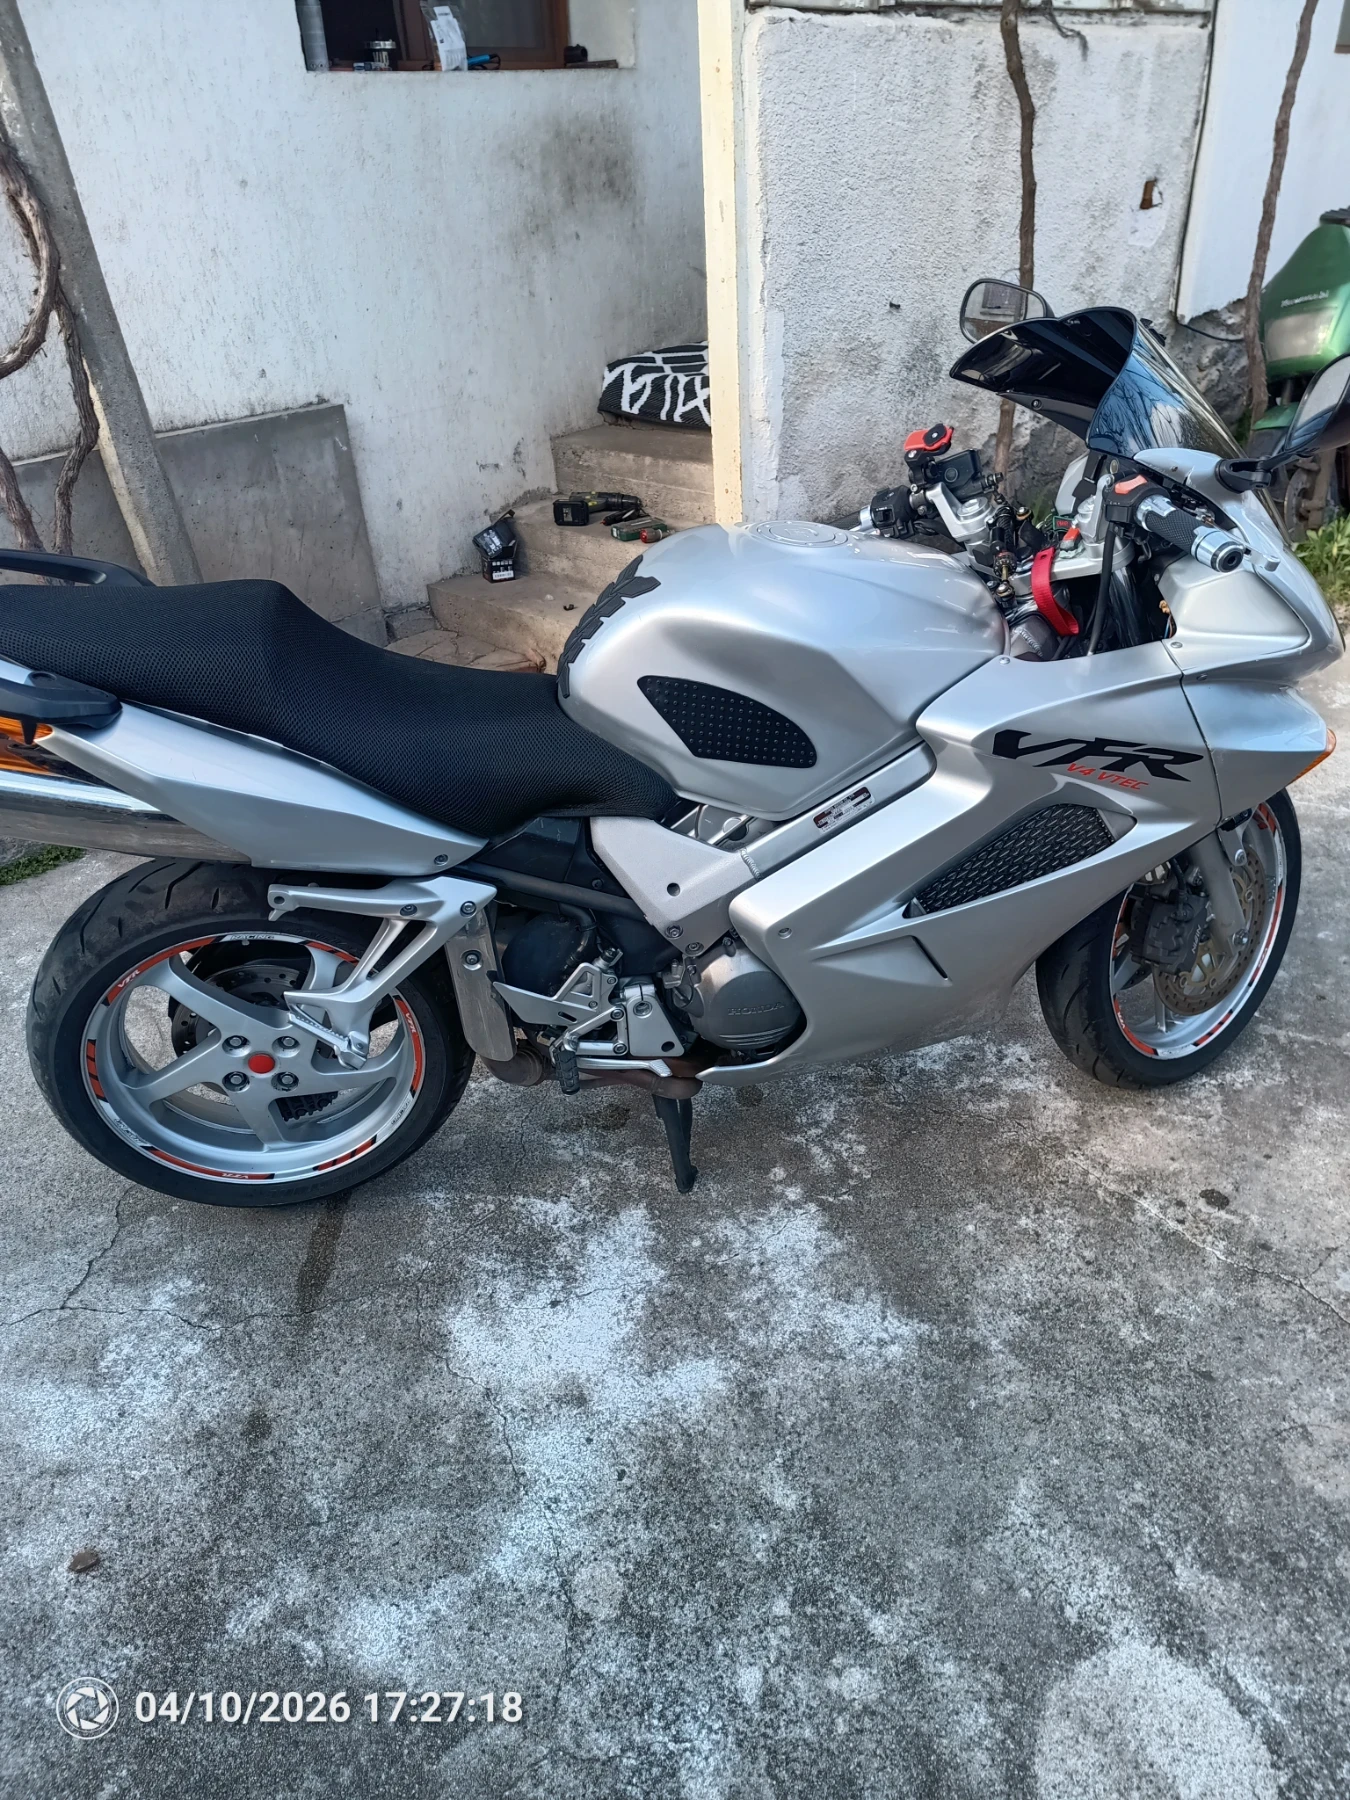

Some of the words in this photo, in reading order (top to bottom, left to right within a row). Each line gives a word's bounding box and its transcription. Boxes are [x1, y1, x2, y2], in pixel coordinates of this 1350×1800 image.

[992, 729, 1204, 782] VFR
[1067, 762, 1096, 776] V4
[1097, 771, 1150, 790] VTEC
[117, 969, 141, 988] VFR
[727, 1002, 785, 1016] HONDA
